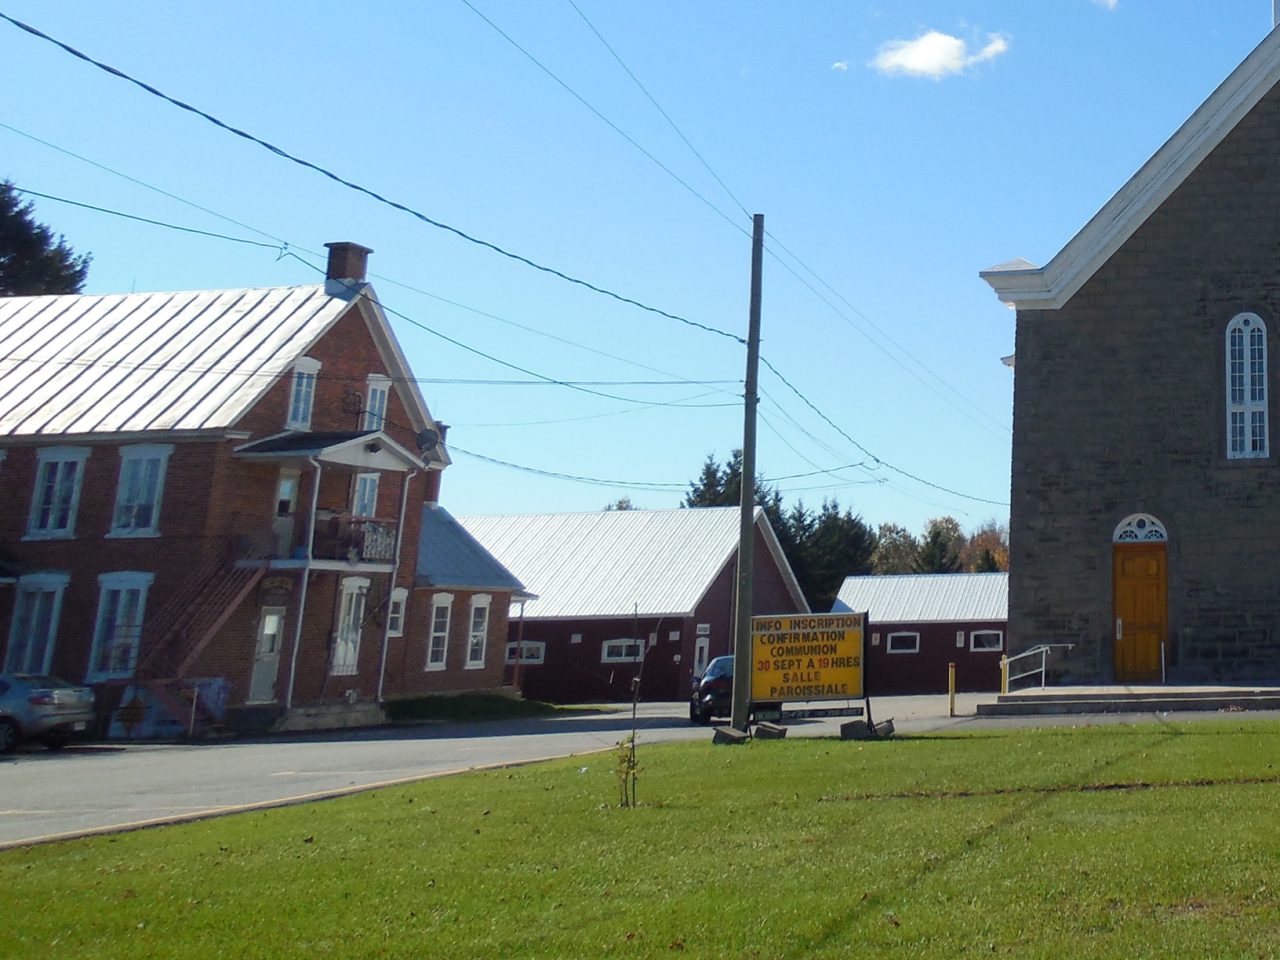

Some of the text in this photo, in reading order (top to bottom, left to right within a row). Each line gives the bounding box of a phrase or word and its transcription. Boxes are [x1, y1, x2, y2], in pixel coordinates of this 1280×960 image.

[756, 617, 860, 632] INFO INSCRIPTION
[760, 630, 845, 645] CONFIRMATION
[770, 644, 837, 657] COMMUNION
[773, 659, 802, 670] SEPT
[831, 656, 860, 668] HRES
[782, 671, 821, 683] SALLE
[770, 683, 848, 697] PAROISSIALE
